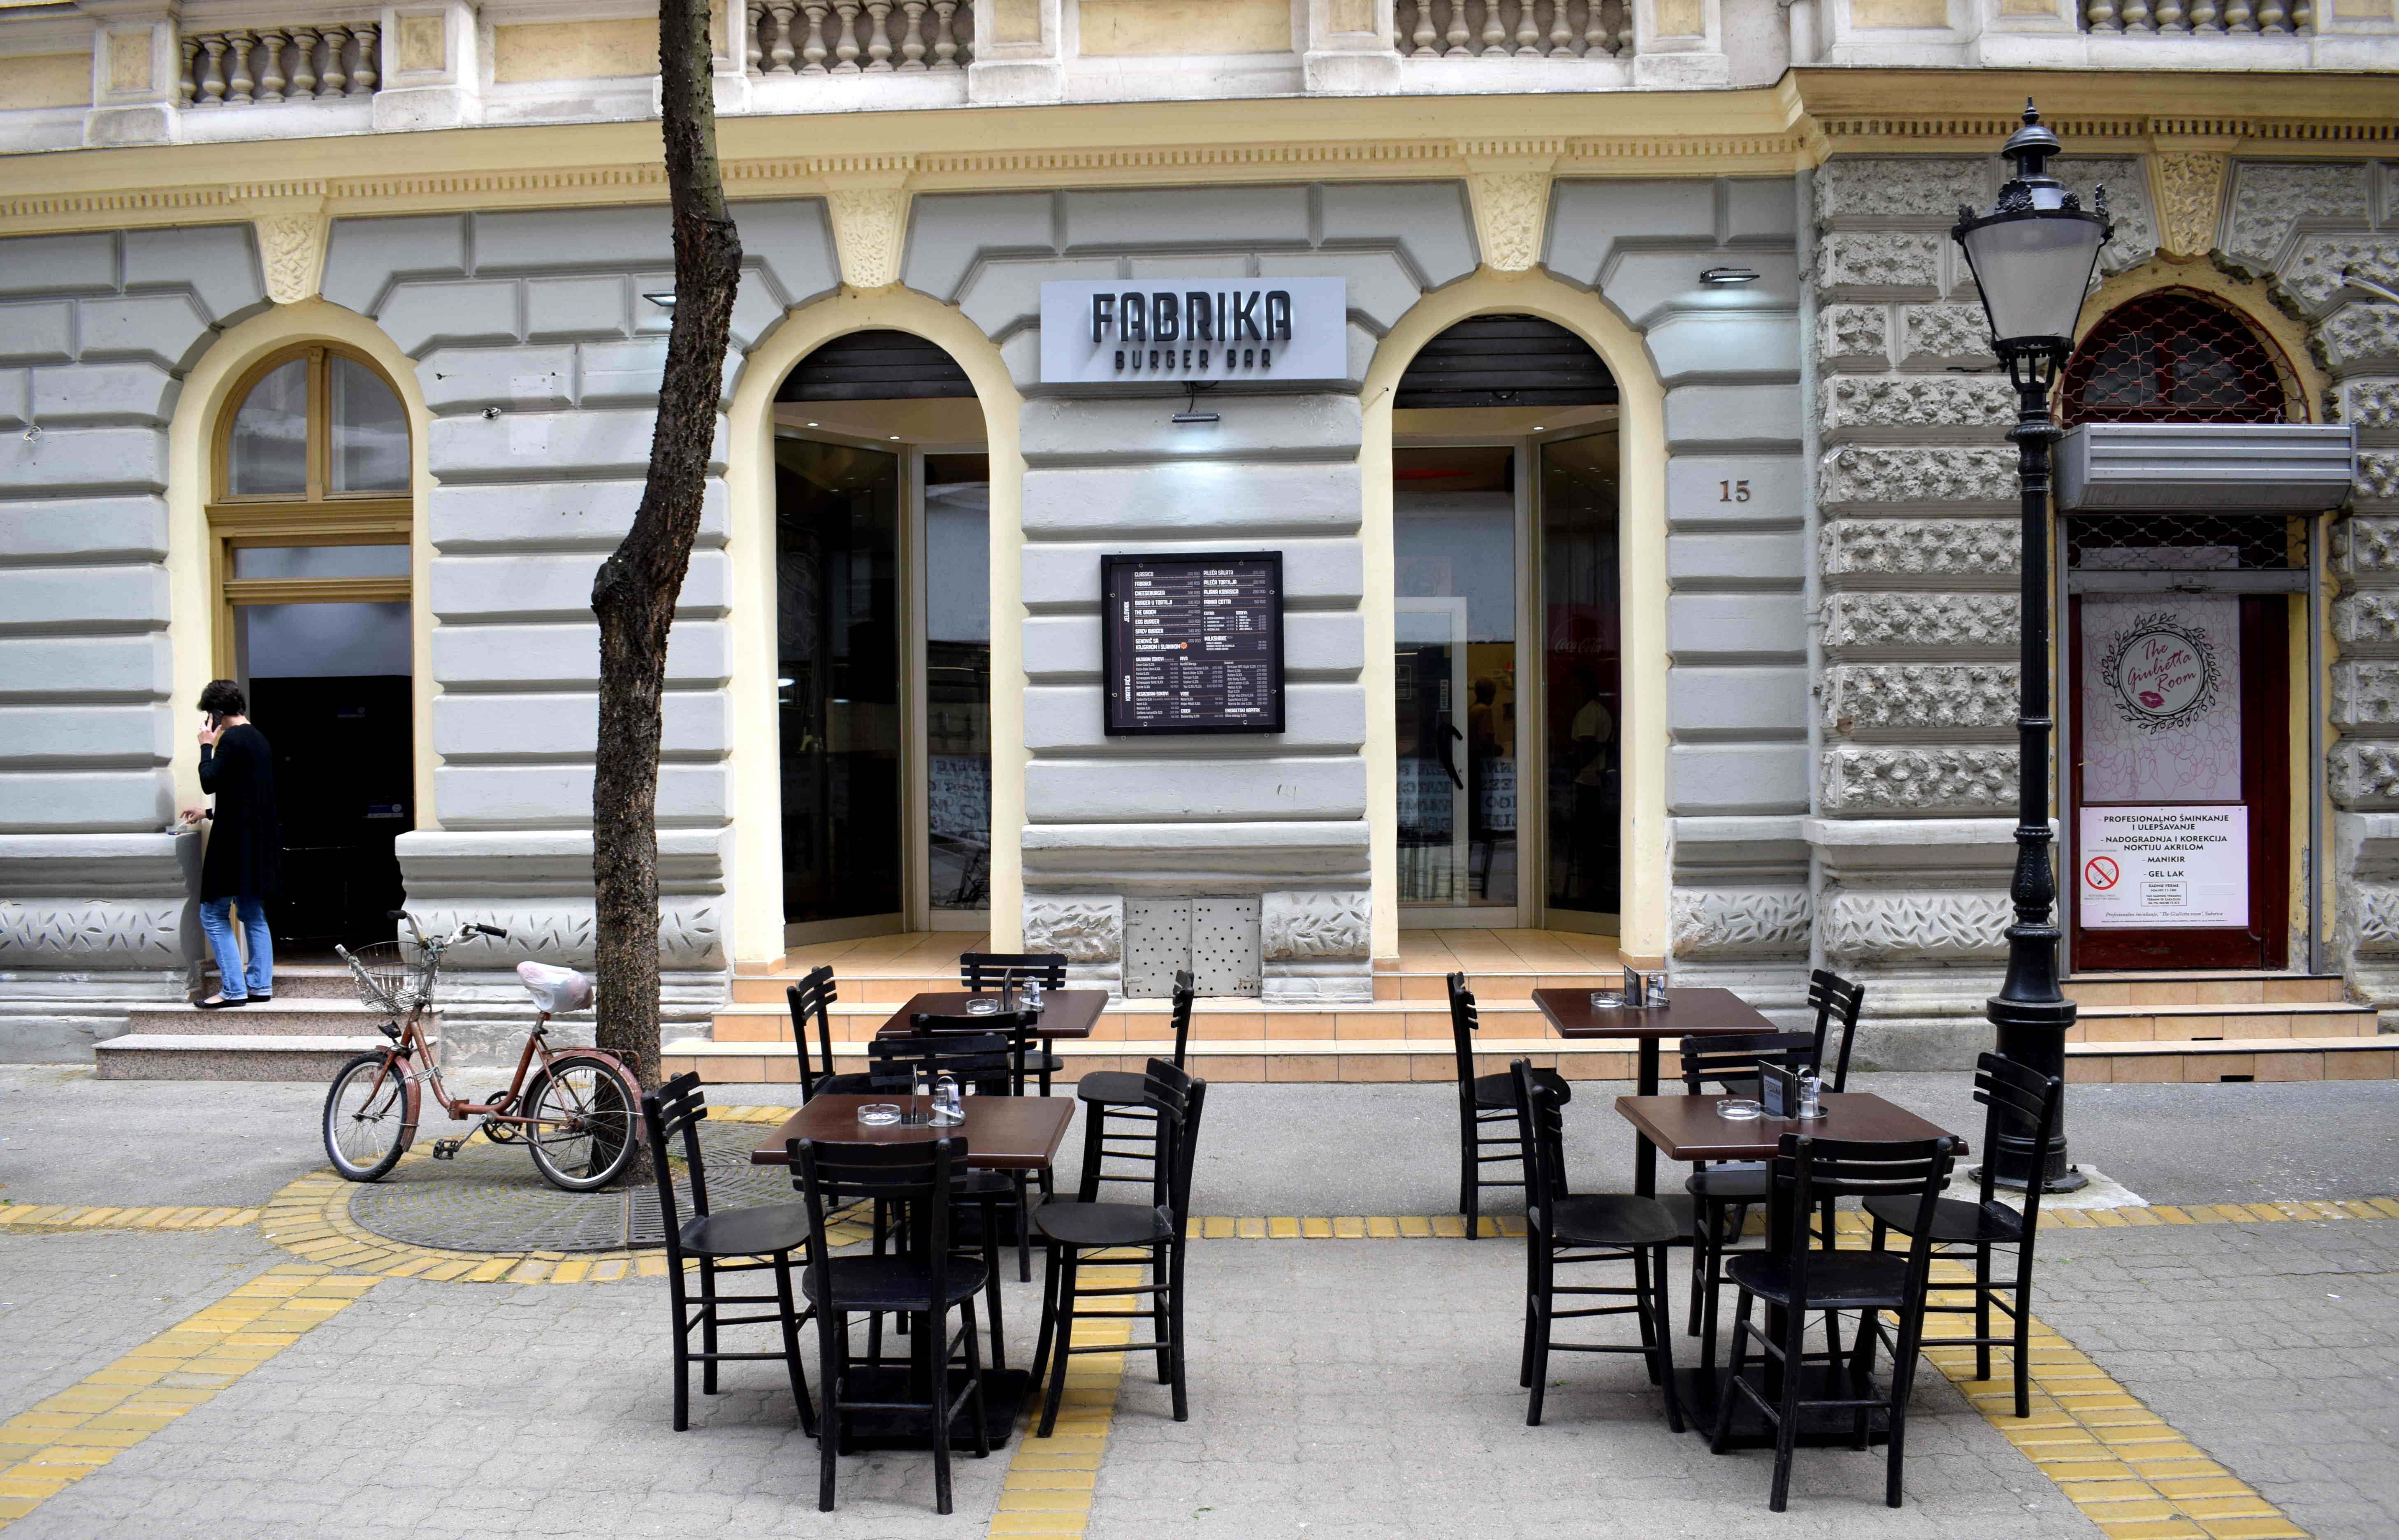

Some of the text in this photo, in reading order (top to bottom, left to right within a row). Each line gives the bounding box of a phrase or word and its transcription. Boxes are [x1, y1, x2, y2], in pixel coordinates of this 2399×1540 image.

[1093, 290, 1291, 343] FABRIKA
[1115, 348, 1271, 369] BURGER BAR
[1719, 480, 1751, 502] 15
[2141, 639, 2168, 660] The
[2128, 649, 2192, 693] Giulietta
[2155, 673, 2196, 692] Room
